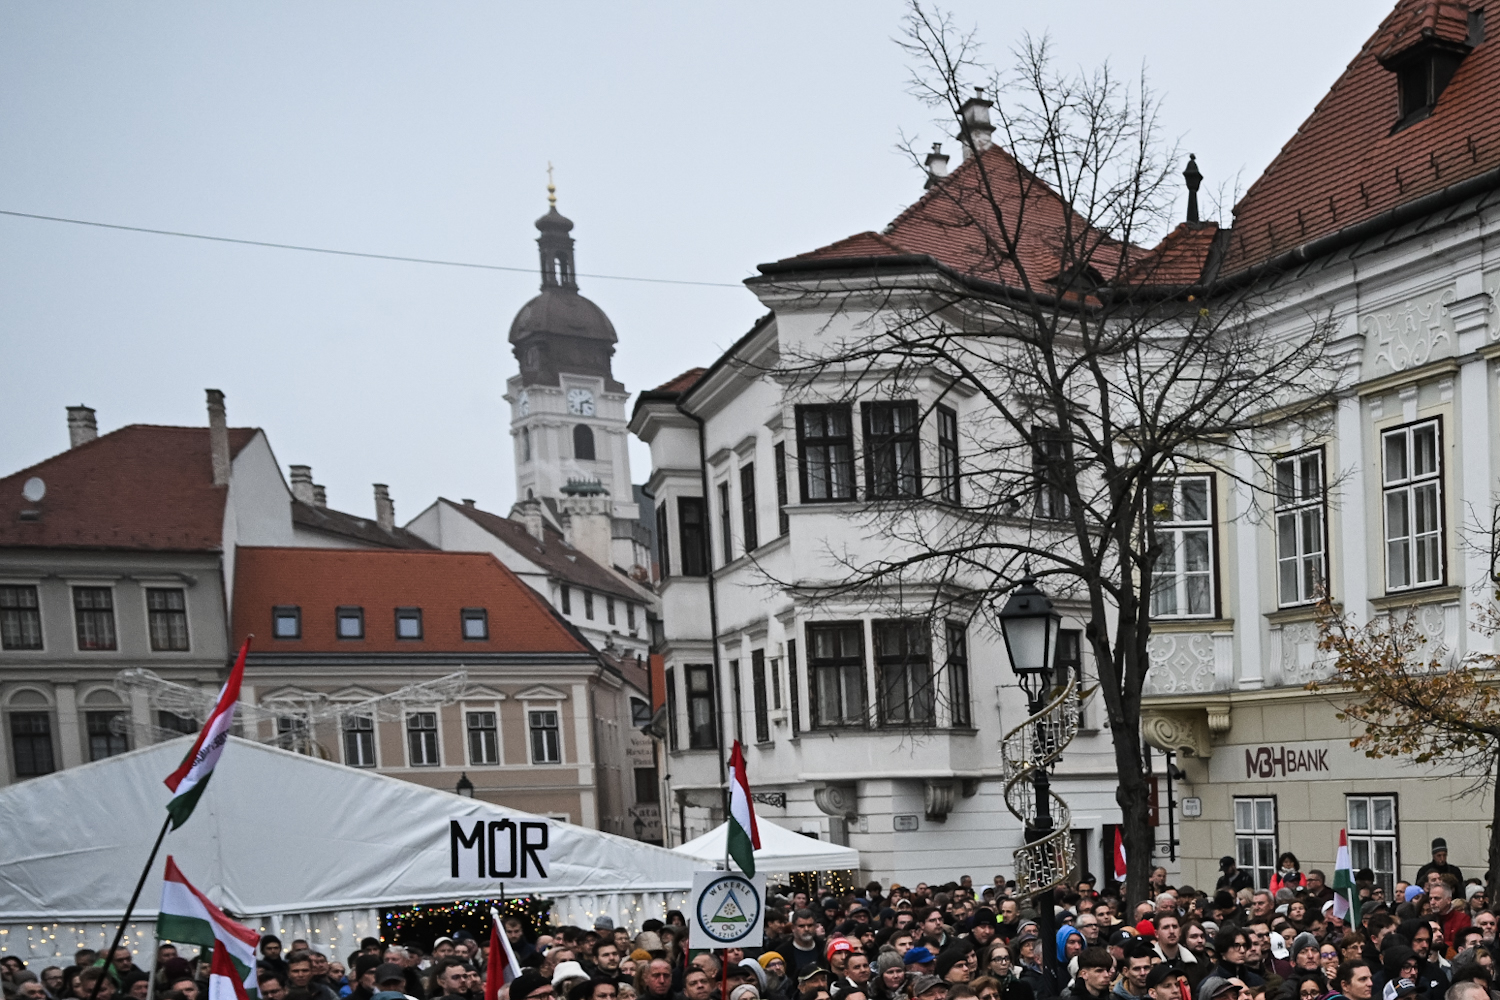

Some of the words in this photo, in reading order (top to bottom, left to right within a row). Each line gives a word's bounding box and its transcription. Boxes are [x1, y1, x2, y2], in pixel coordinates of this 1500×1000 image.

[1246, 746, 1287, 778] MBH
[1286, 749, 1329, 772] BANK
[450, 818, 549, 878] MÓR
[709, 882, 751, 896] WEKERLE
[702, 914, 743, 938] TISZA-SZIGET
[744, 913, 755, 928] MÓR
